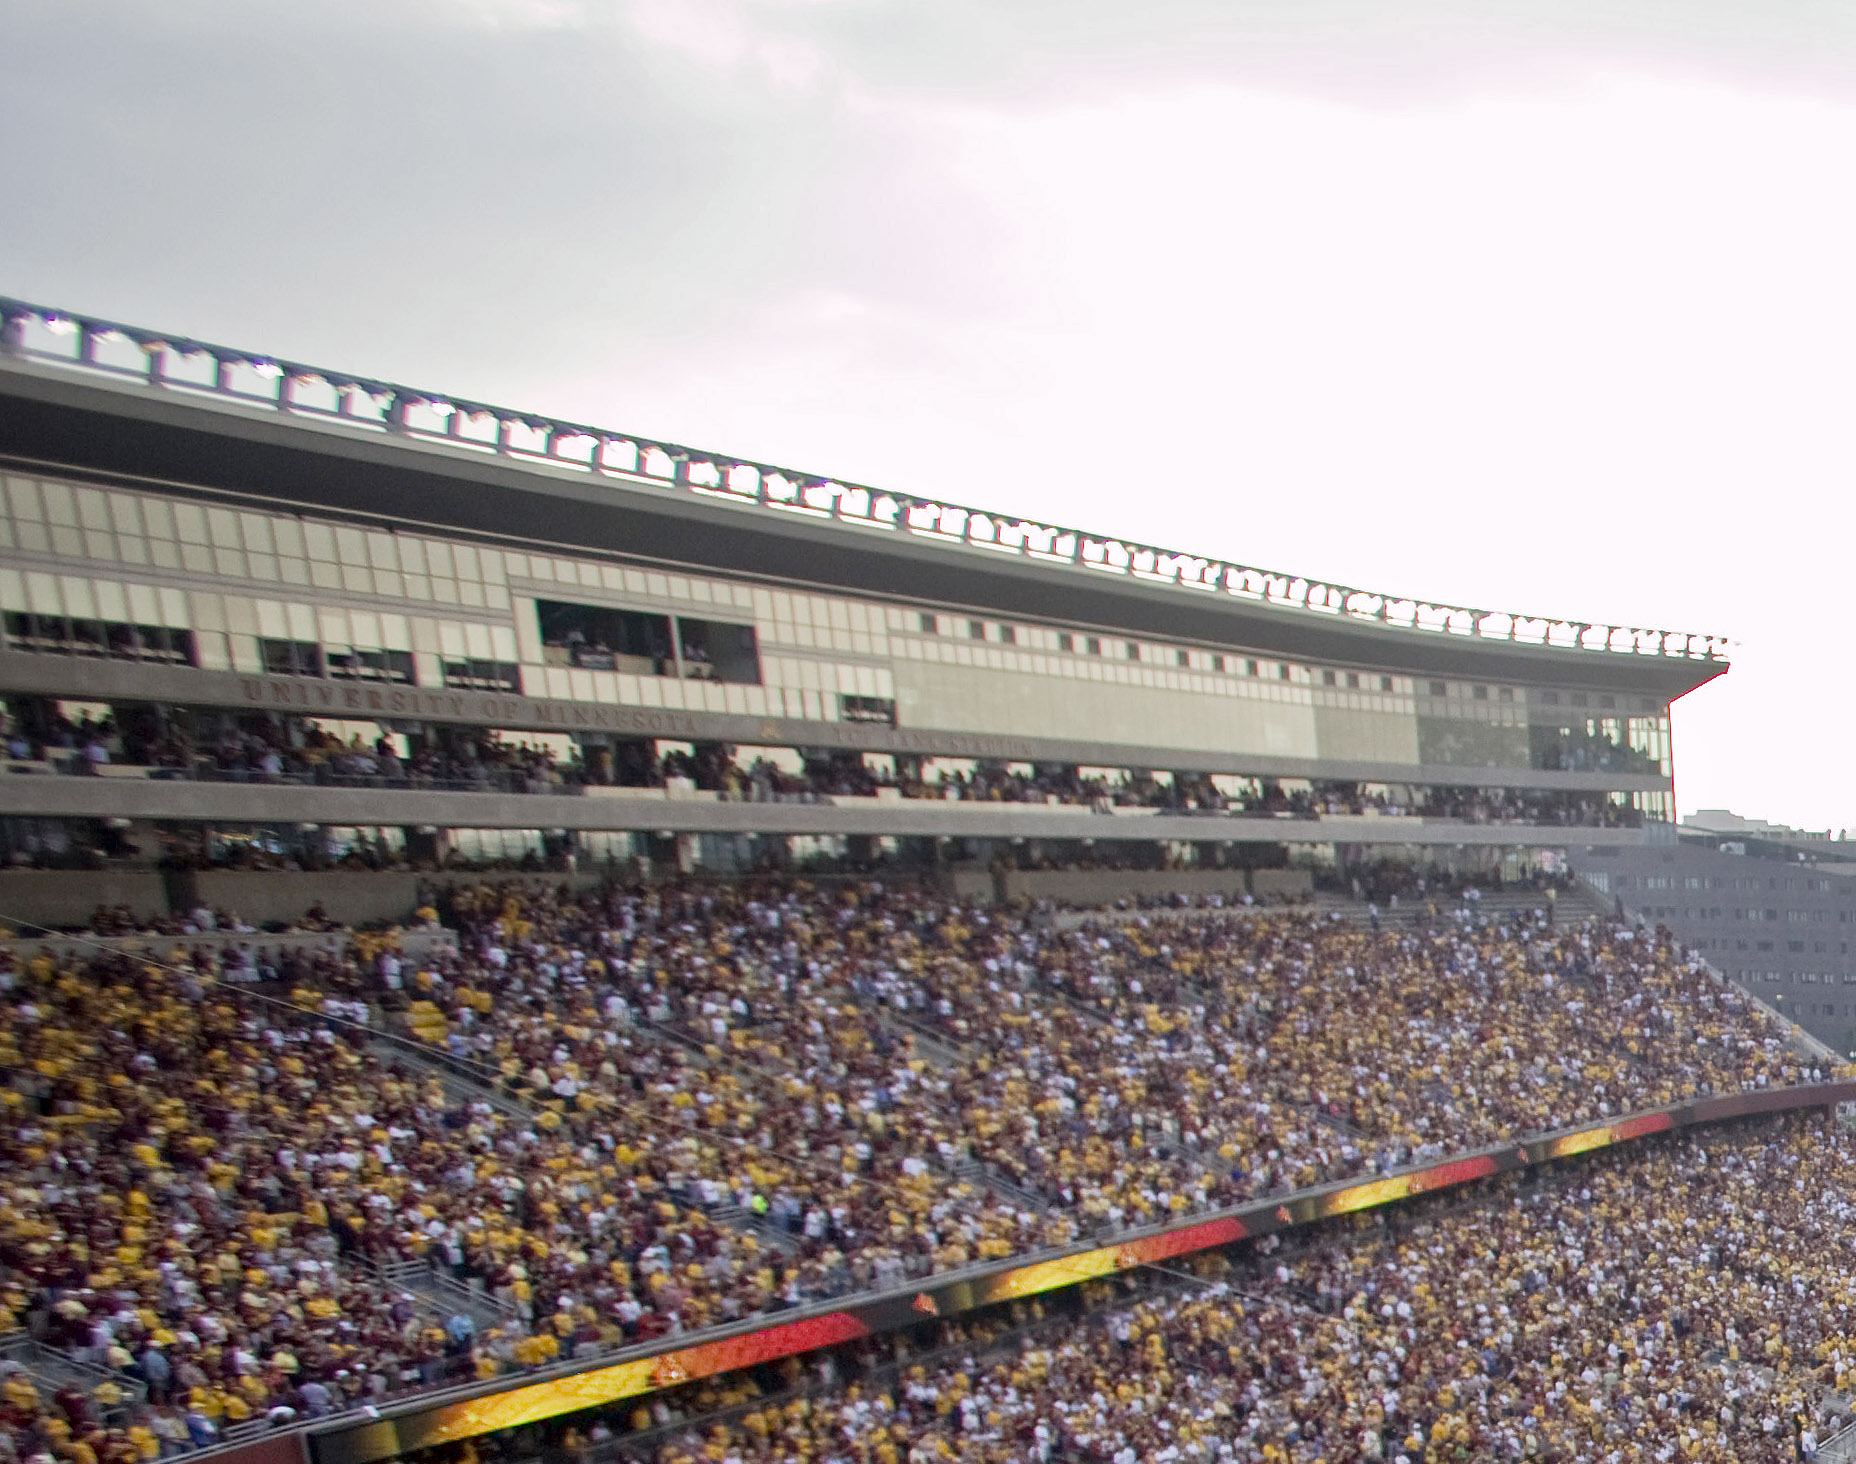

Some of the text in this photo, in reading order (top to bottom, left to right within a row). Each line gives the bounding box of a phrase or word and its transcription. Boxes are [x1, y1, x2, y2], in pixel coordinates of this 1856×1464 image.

[243, 680, 697, 731] UNIVERSITY OF MINNESOTA
